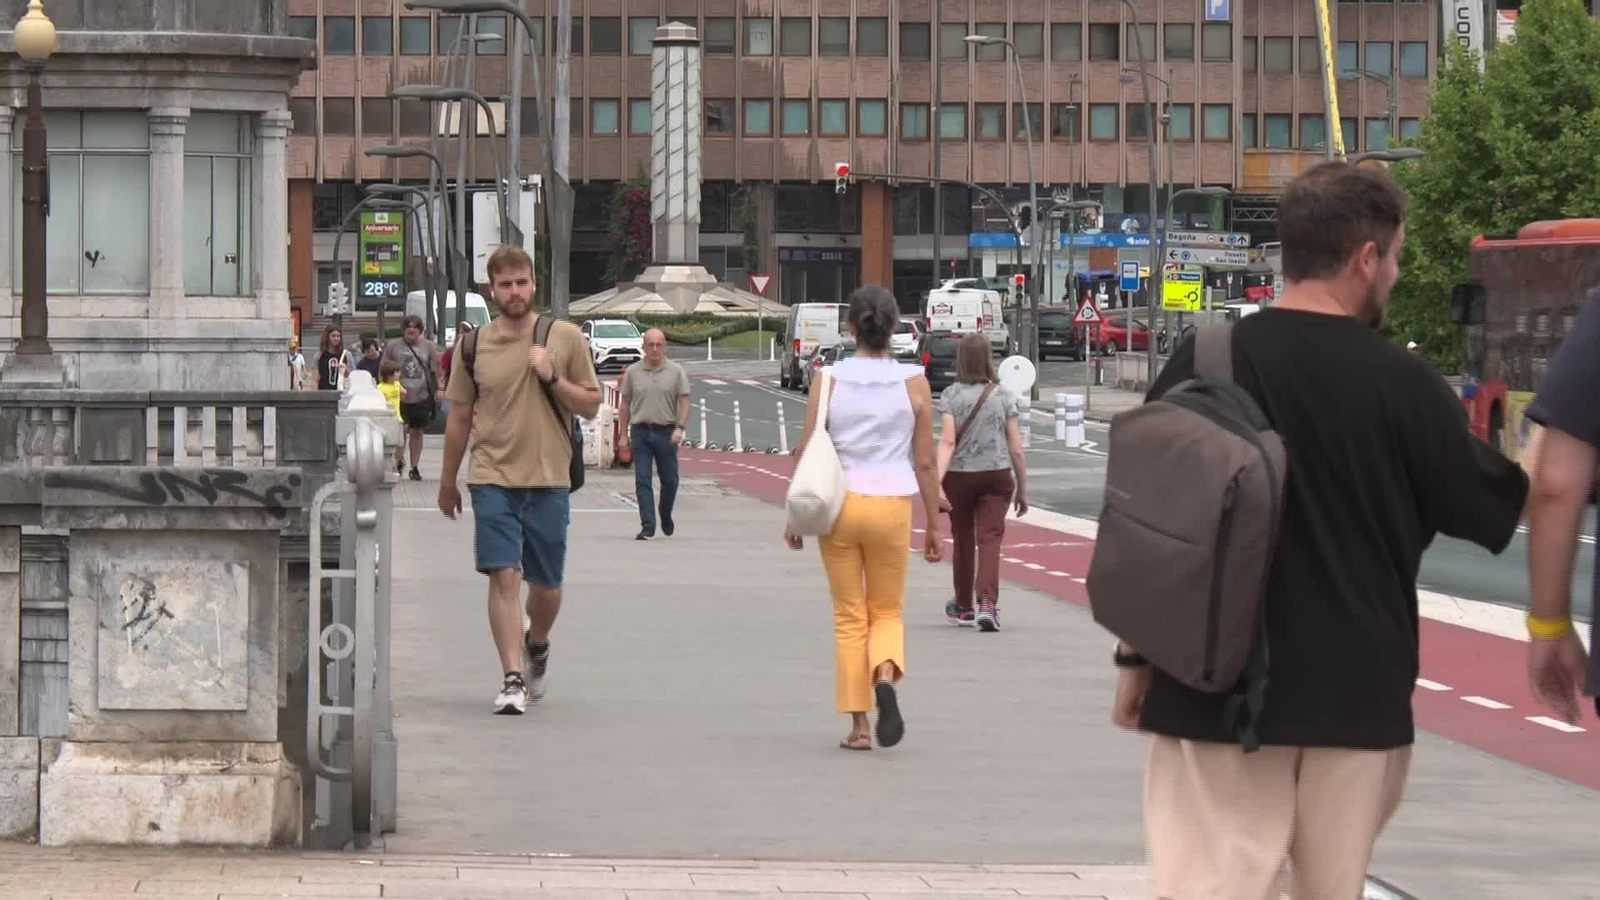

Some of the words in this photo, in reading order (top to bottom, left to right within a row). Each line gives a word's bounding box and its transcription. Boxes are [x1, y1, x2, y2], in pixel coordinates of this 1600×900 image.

[365, 224, 400, 232] Aniversario
[1168, 233, 1196, 241] Begoña
[364, 281, 398, 296] 28°C
